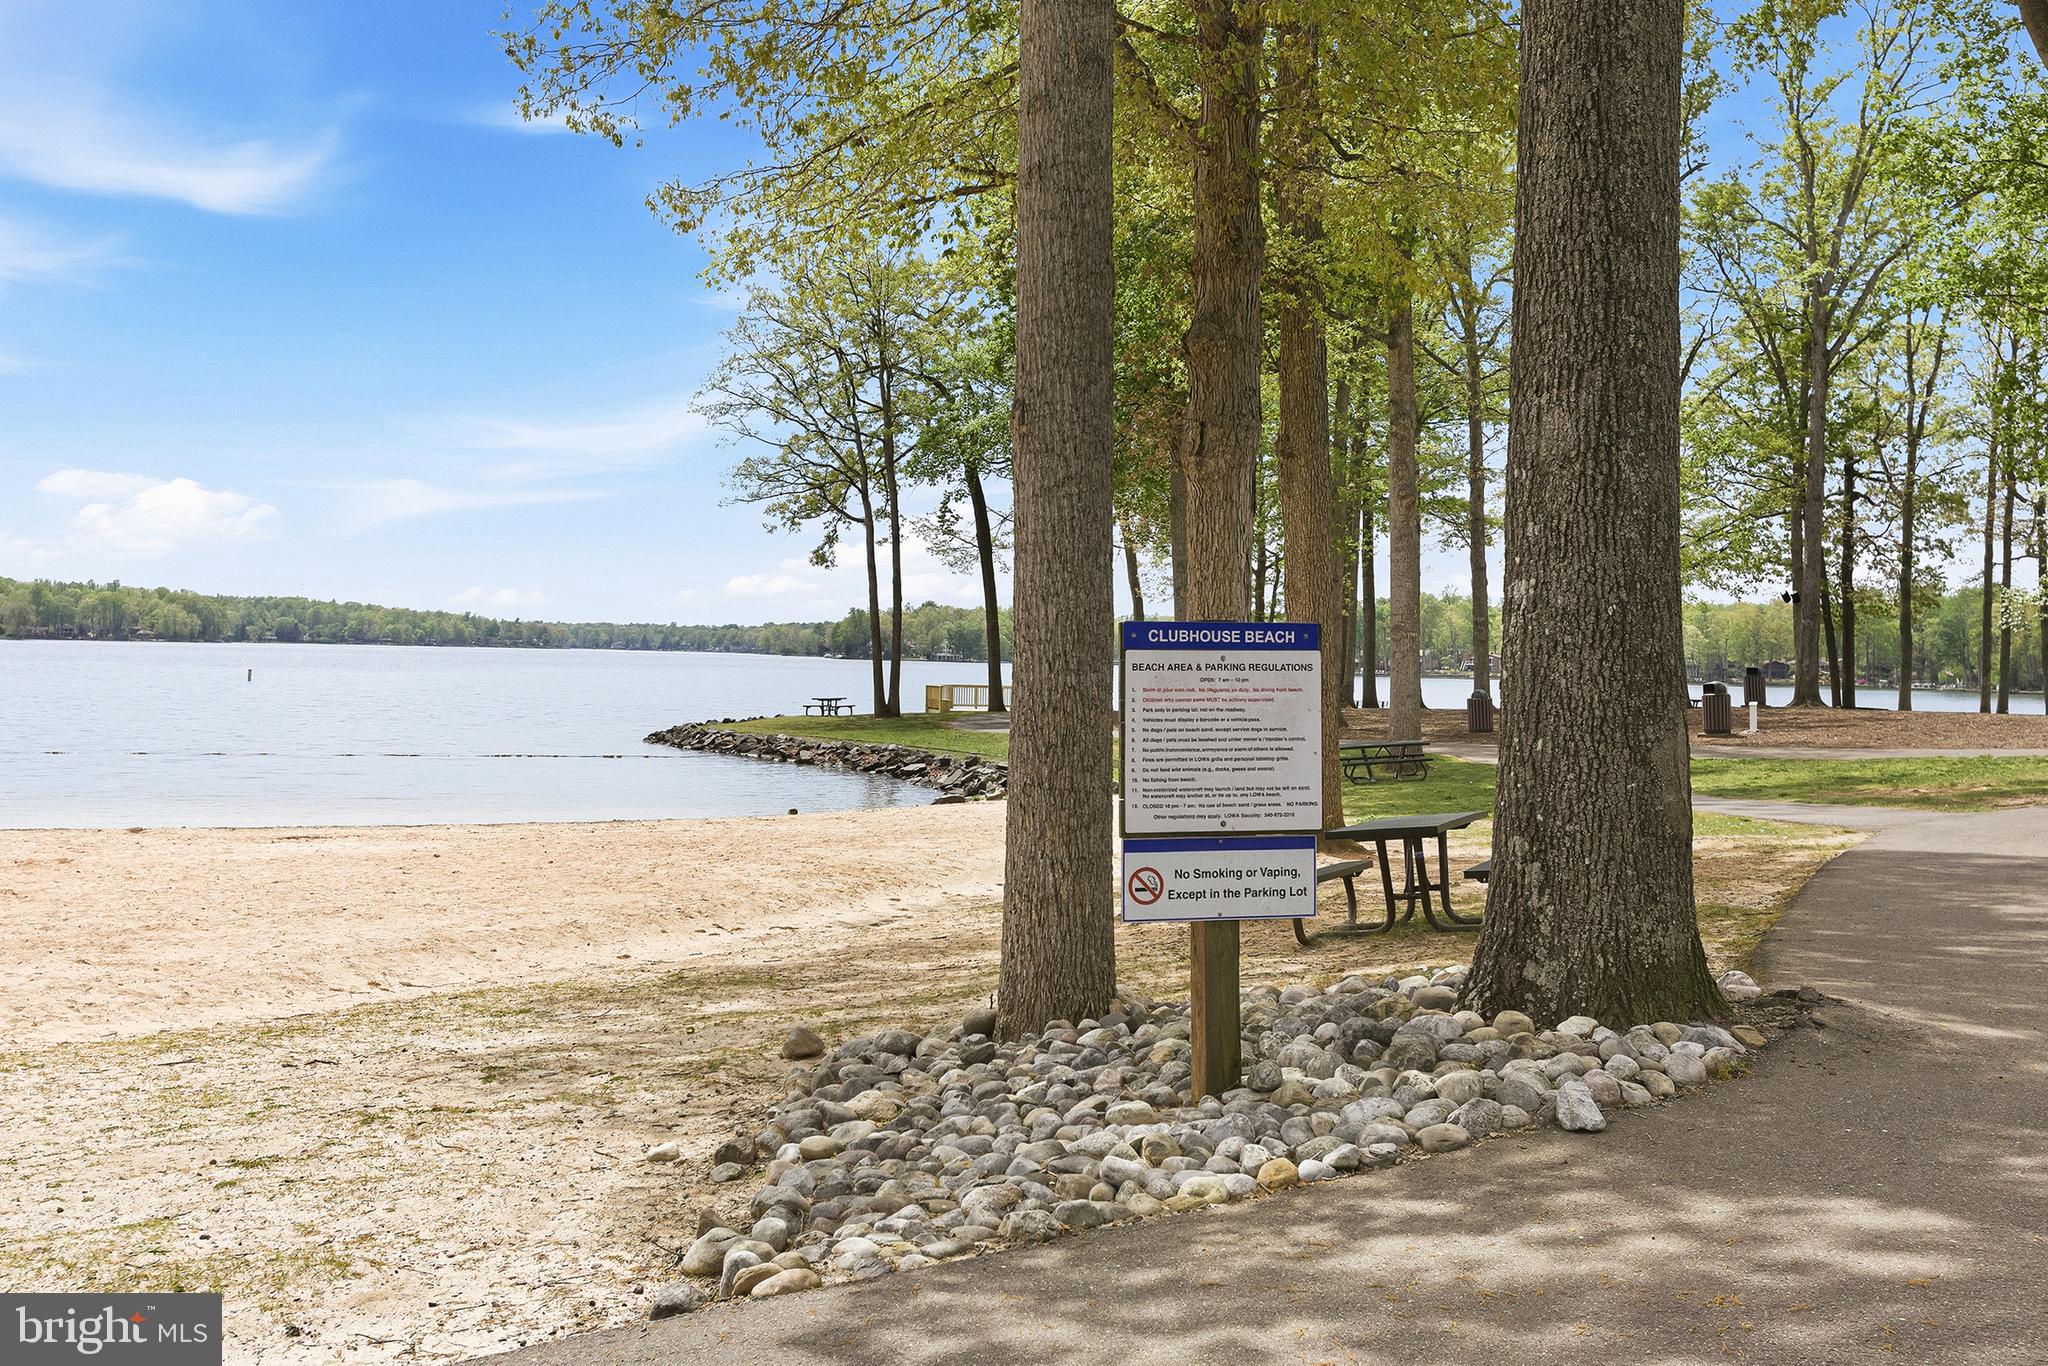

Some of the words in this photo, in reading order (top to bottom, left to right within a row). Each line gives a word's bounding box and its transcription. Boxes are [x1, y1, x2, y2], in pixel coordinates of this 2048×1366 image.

[1148, 629, 1240, 643] CLUBHOUSE
[1245, 630, 1295, 643] BEACH
[1205, 664, 1246, 672] PARKING
[1249, 664, 1313, 672] REGULATIONS
[1174, 869, 1189, 879] No
[1193, 868, 1243, 880] Smoking
[1260, 867, 1301, 879] Vaping,
[1168, 889, 1206, 902] Except
[1210, 889, 1219, 898] in
[1223, 889, 1240, 898] the
[1244, 887, 1286, 899] Parking
[1290, 887, 1307, 896] Lot
